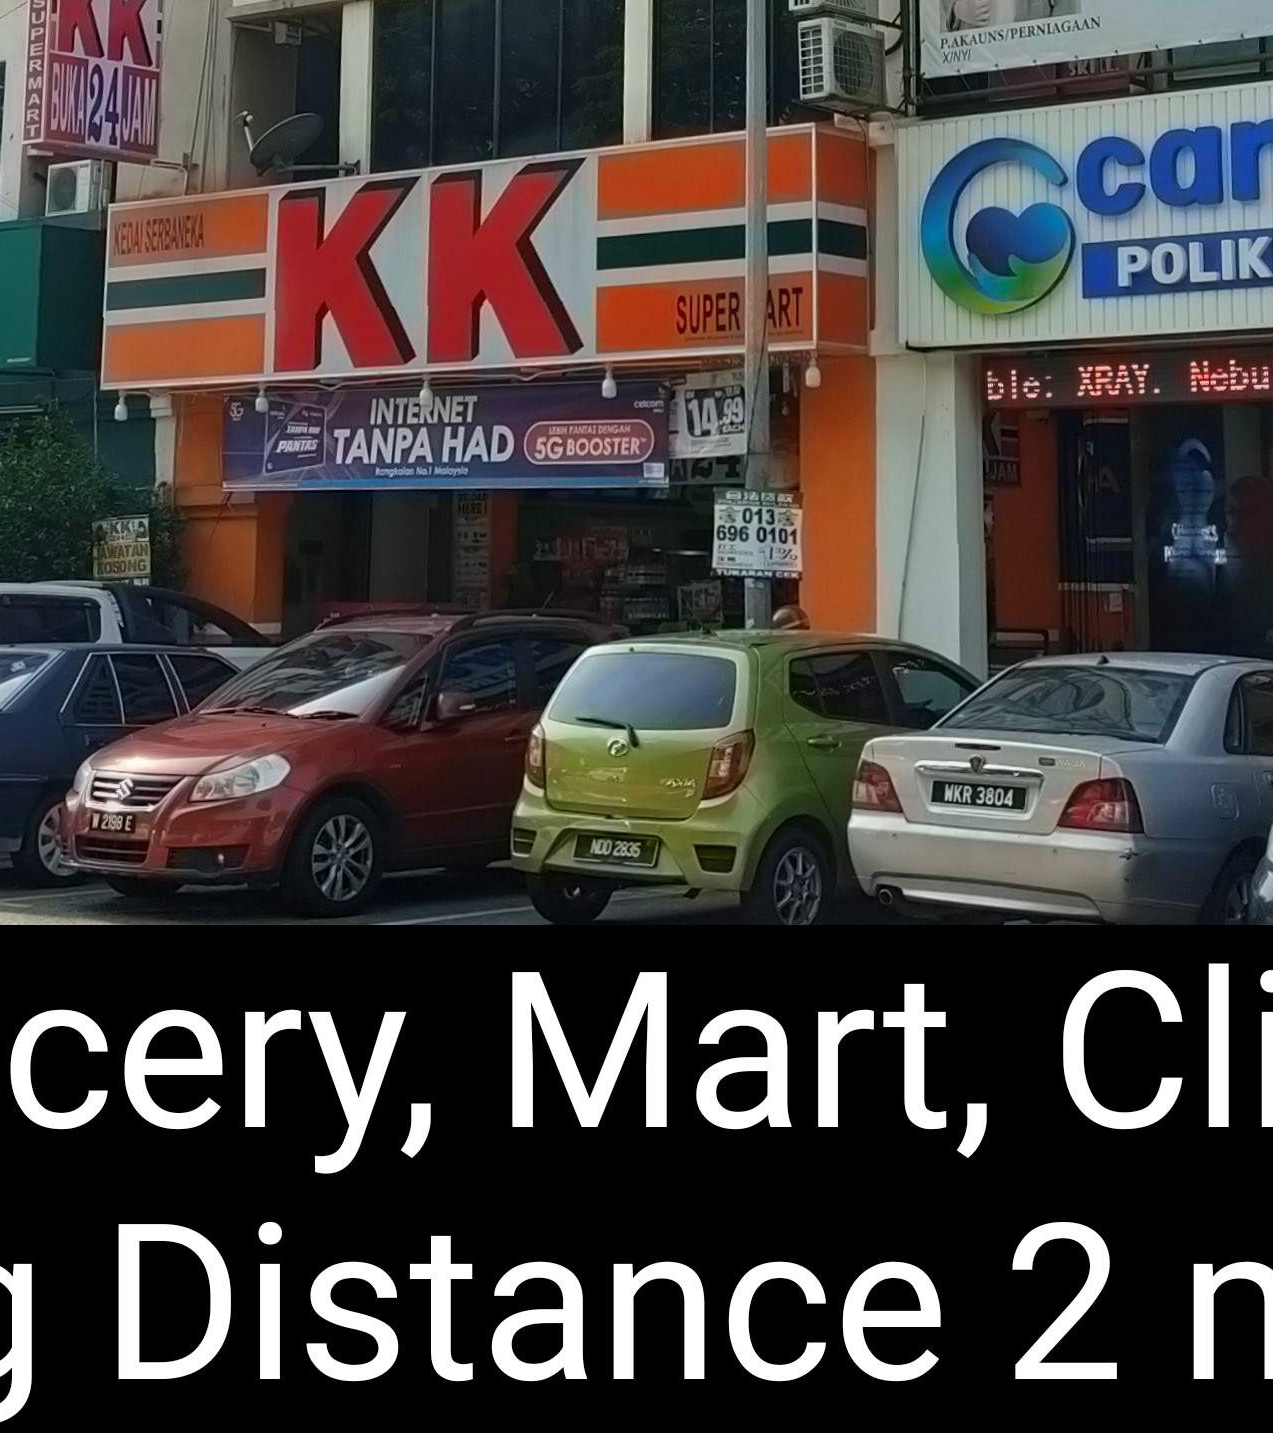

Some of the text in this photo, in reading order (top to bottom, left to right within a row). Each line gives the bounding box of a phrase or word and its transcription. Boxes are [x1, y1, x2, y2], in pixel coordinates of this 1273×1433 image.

[940, 15, 1103, 50] P.AKAUNS/PERNIAGAAN
[942, 48, 972, 64] XINYI
[50, 62, 157, 147] BUKA 24 JAM
[113, 213, 205, 256] KEDAI SERBANEKA
[274, 156, 588, 372] KK
[676, 286, 804, 336] SUPERART
[369, 394, 478, 426] INTERNET
[276, 439, 319, 454] PANTAS
[333, 423, 514, 465] TANPA HAD
[534, 438, 564, 461] 5G
[742, 508, 776, 525] 013
[716, 525, 798, 545] 696 0101
[944, 783, 1014, 807] WKR 3804
[124, 815, 133, 832] E
[612, 840, 642, 858] 2835
